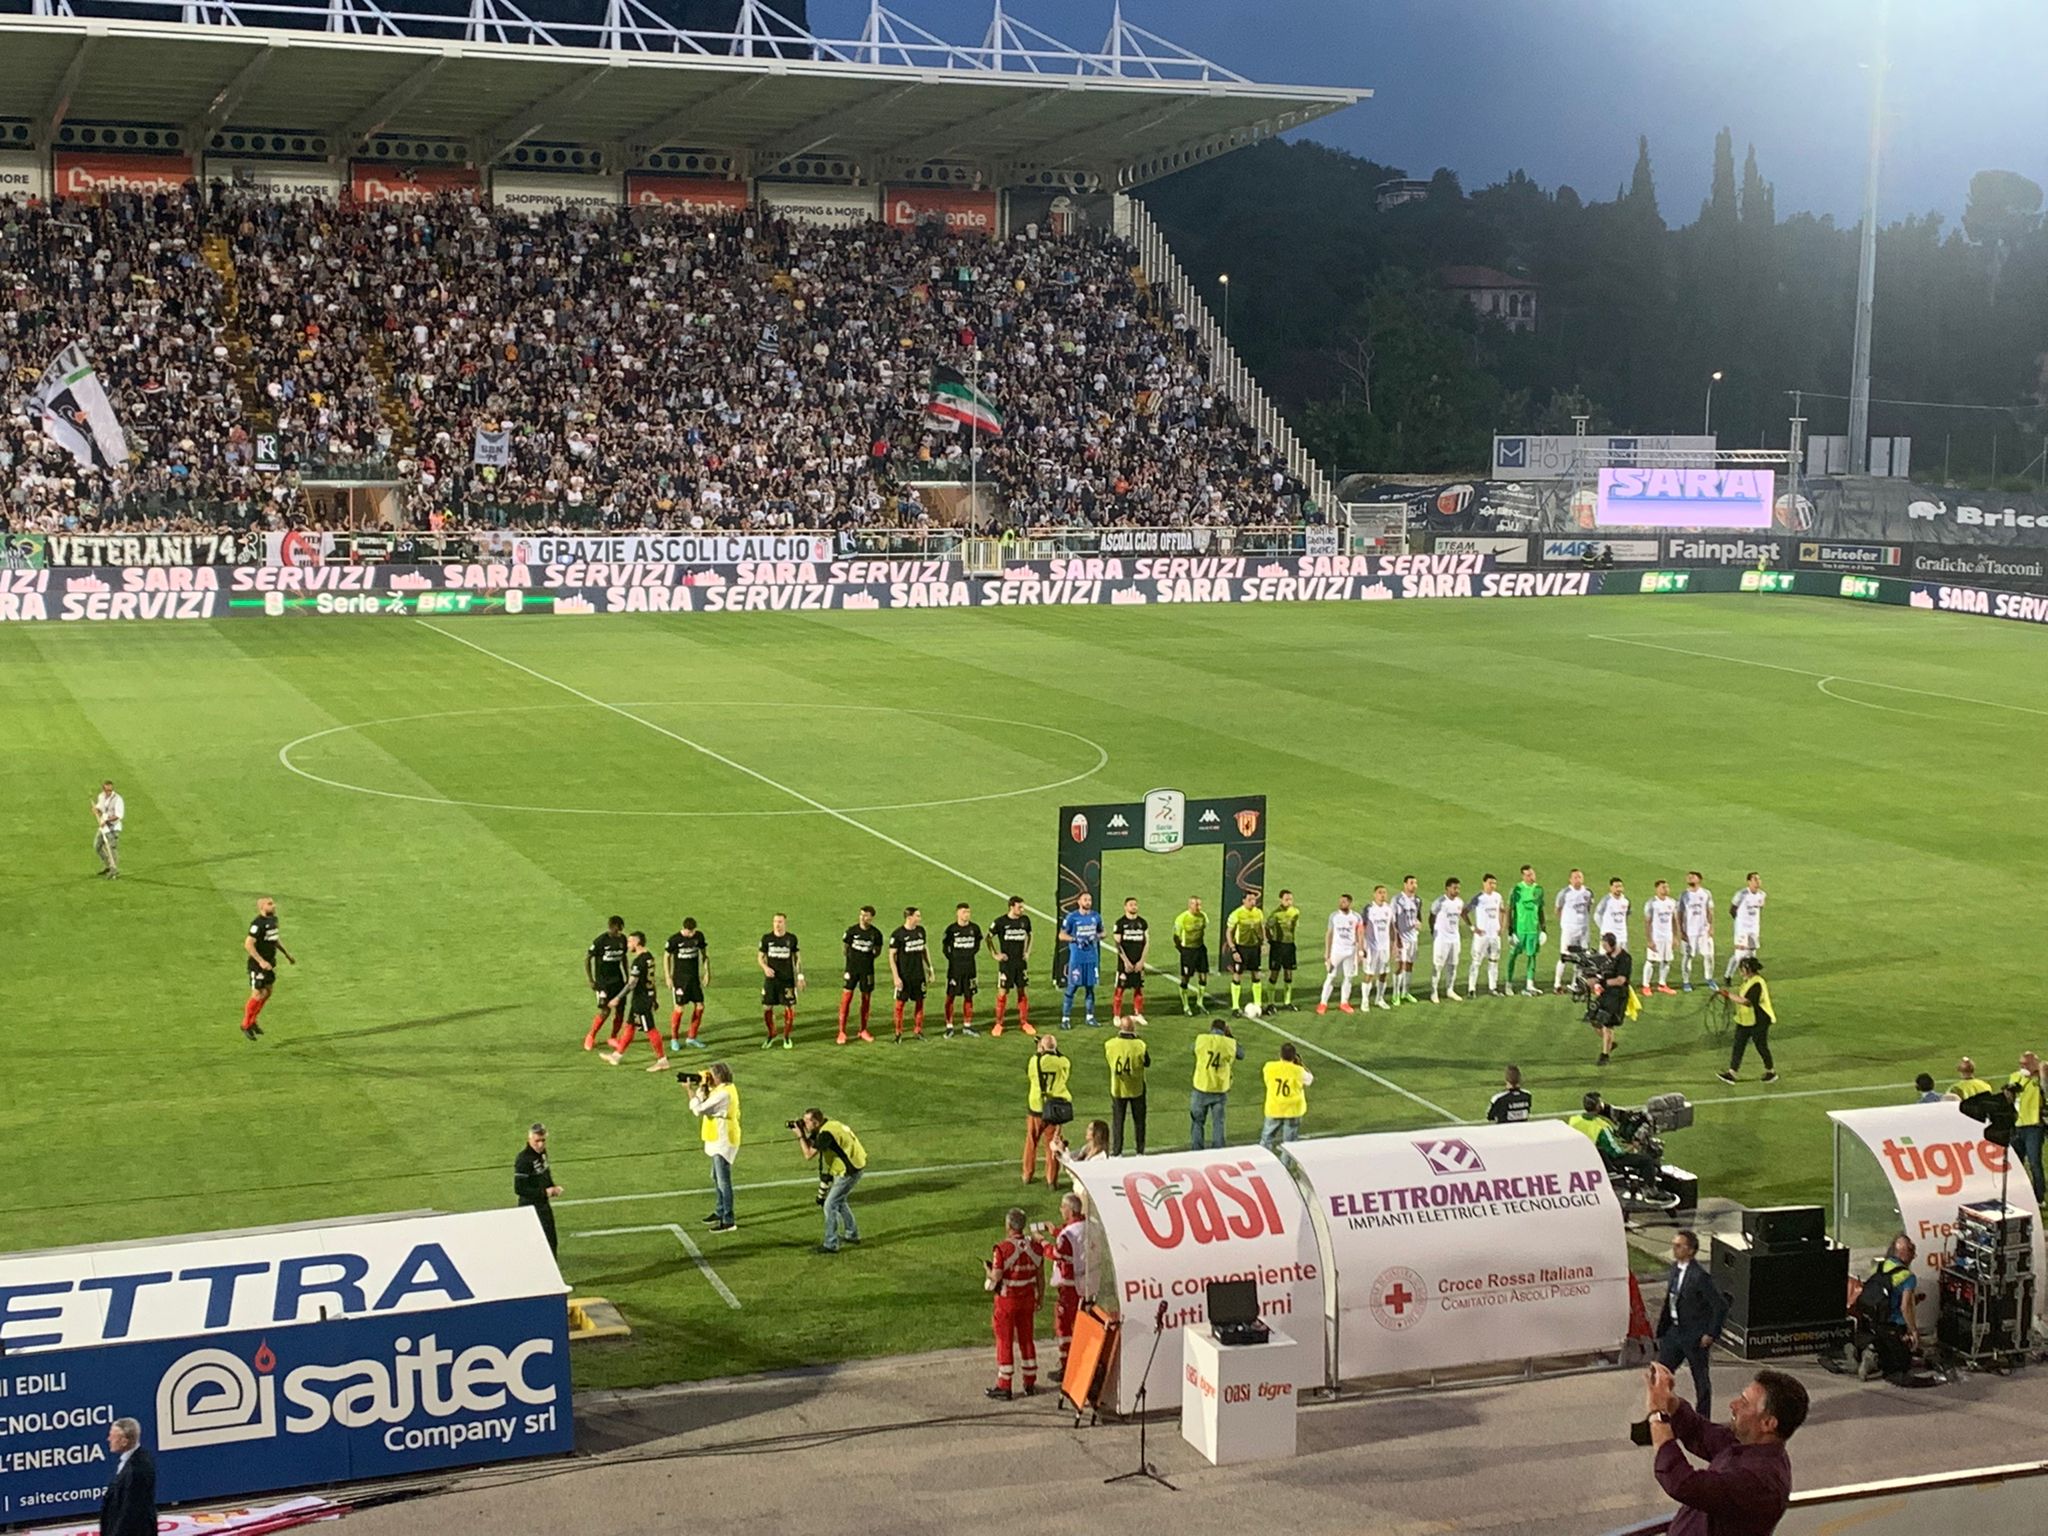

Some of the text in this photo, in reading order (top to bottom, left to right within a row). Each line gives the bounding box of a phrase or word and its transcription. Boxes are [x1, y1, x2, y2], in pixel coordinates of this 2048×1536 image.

[505, 193, 561, 208] SHOPPING
[772, 204, 823, 217] SHOPPING
[834, 207, 865, 218] MORE
[1611, 469, 1763, 498] SARA
[633, 539, 718, 563] ASCOLI
[726, 538, 810, 562] CALCIO
[1101, 532, 1192, 551] ASCOLI CLUB OFFIDA
[1669, 539, 1780, 565] Fainplast
[1822, 547, 1878, 560] Bricofer
[444, 562, 675, 588] SARA SERVIZI
[736, 560, 949, 585] SARA SERVIZI
[1050, 557, 1246, 580] SARA SERVIZI
[1298, 554, 1485, 577] SARA SERVIZI
[1915, 555, 1975, 575] Grafiche
[122, 565, 375, 592] SARA SERVIZI
[1157, 576, 1354, 602] SARA SERVIZI
[1402, 572, 1589, 598] SARA SERVIZI
[1640, 572, 1690, 592] BKT
[1740, 571, 1795, 591] BKT
[1840, 575, 1879, 598] BKT
[61, 591, 215, 620] SERVIZI
[316, 592, 473, 614] Serie BKT
[606, 584, 834, 613] SARA SERVIZI
[890, 580, 1102, 607] SARA SERVIZI
[1938, 586, 1989, 614] SARA
[1115, 1056, 1132, 1076] 64
[1207, 1050, 1221, 1071] 74
[1275, 1078, 1291, 1098] 76
[1882, 1136, 2013, 1195] tigre
[1330, 1170, 1602, 1217] ELETTROMARCHE AP
[1349, 1193, 1601, 1230] IMPIANTI ELETTRICI E TECNOLOGICI
[1124, 1277, 1163, 1303] Più
[1438, 1265, 1594, 1294] Croce Rossa Italiana
[15, 1372, 67, 1396] EDILI
[1257, 1381, 1292, 1401] tigre
[384, 1406, 557, 1453] Company srl
